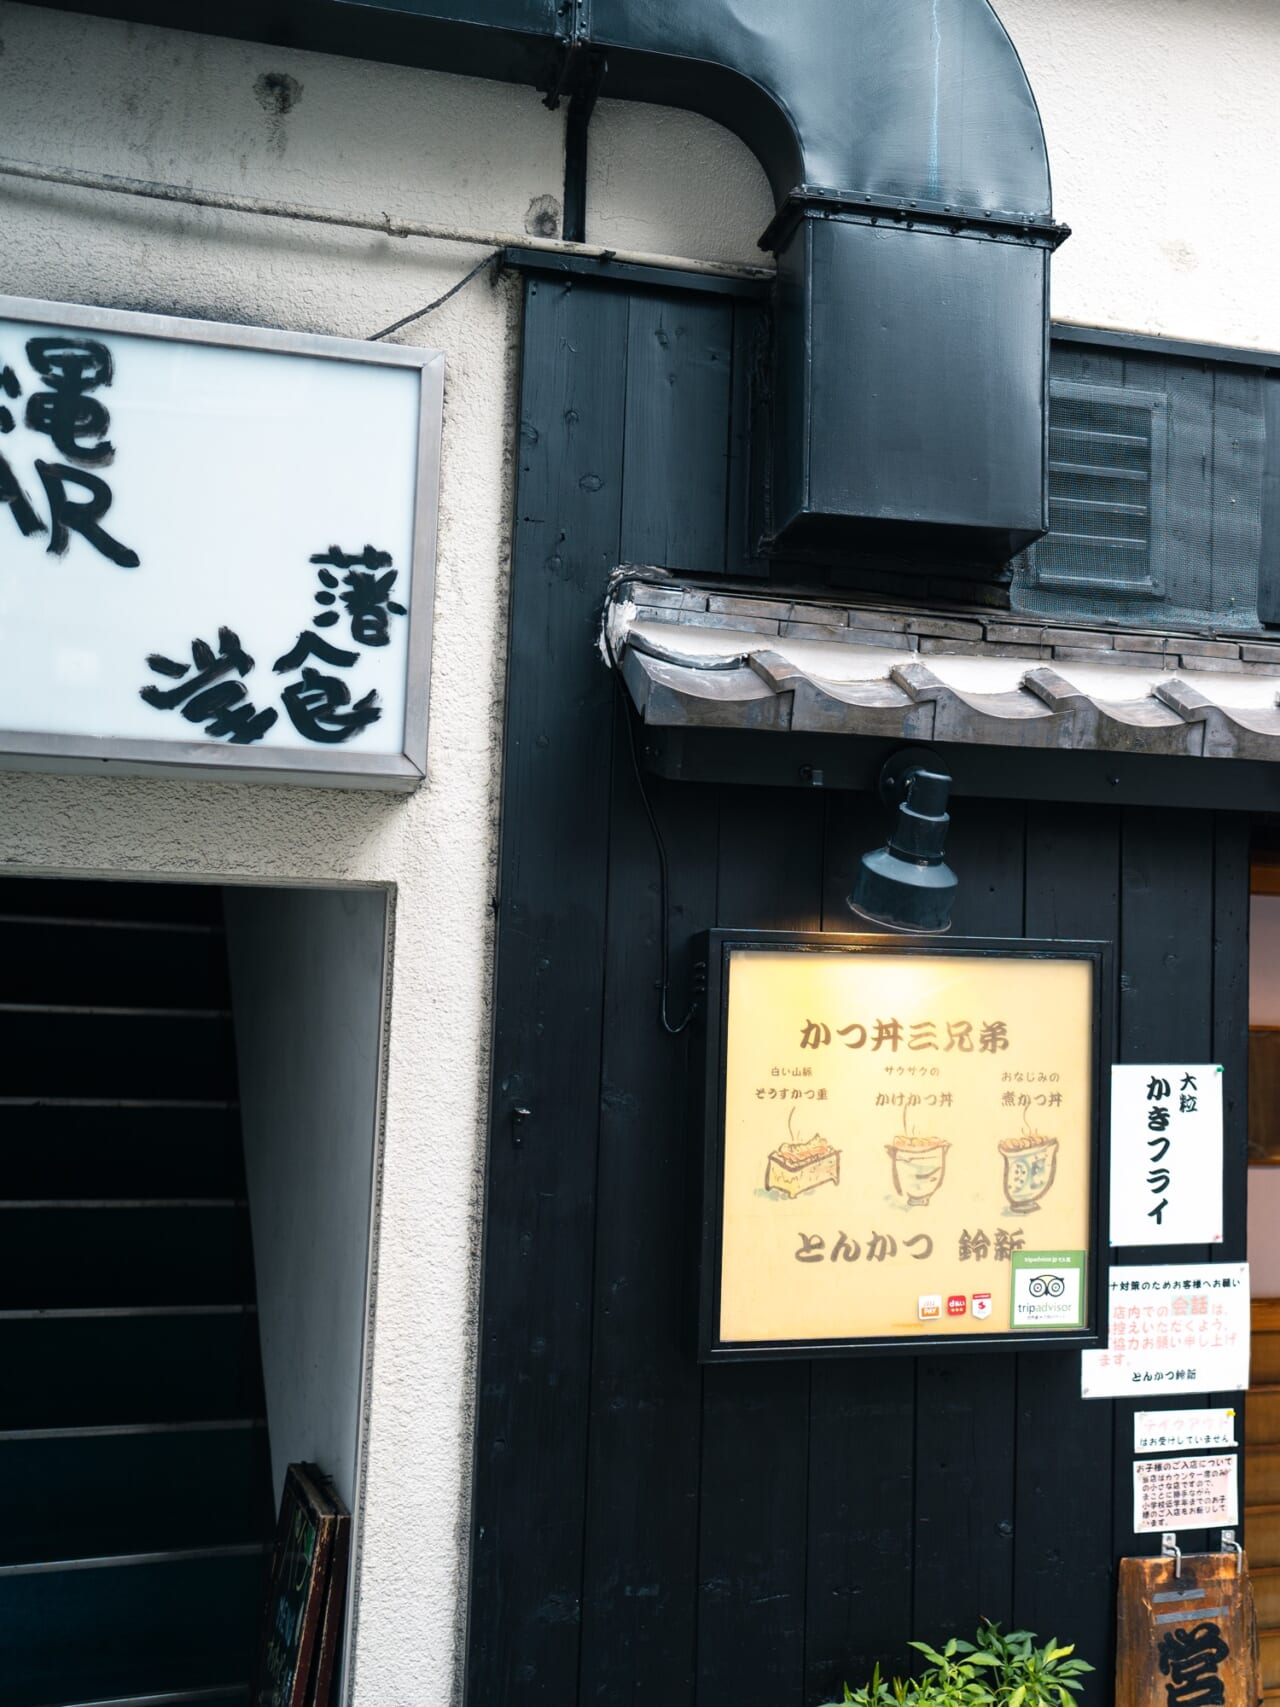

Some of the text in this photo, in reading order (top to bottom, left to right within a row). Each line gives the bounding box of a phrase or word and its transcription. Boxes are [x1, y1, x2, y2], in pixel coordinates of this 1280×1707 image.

[800, 1017, 1009, 1054] かつ丼三兄弟
[771, 1066, 812, 1077] 白い山脈
[884, 1066, 940, 1076] サクサクの
[1001, 1072, 1060, 1083] おなじみの
[875, 1091, 953, 1108] かけかつ丼
[1001, 1090, 1063, 1107] 煮かつ丼
[1179, 1072, 1198, 1113] 大粒
[1146, 1075, 1171, 1225] かきフライ
[795, 1227, 1026, 1263] とんかつ 鈴新
[1018, 1302, 1072, 1315] tripadvisor
[1140, 1435, 1229, 1447] はお受けしていません
[1137, 1457, 1232, 1473] お子様のご入店について
